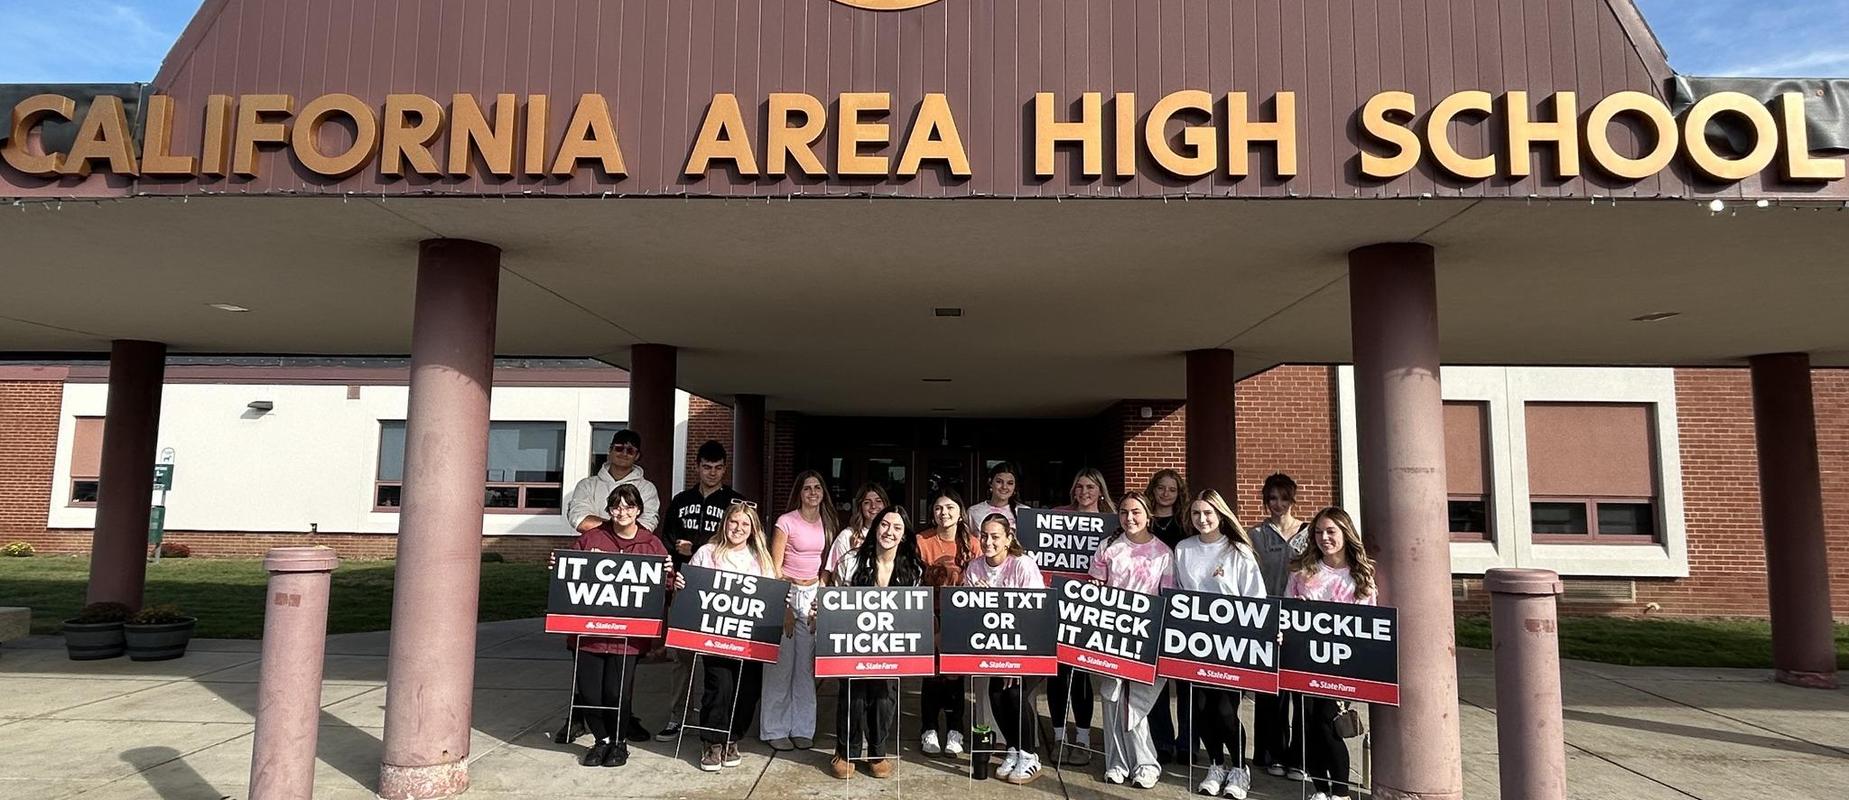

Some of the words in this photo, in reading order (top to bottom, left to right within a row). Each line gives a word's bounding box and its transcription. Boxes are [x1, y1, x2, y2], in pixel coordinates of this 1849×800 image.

[0, 93, 628, 178] CALIFORNIA
[684, 92, 972, 180] AREA
[1035, 89, 1297, 178] HIGH
[1359, 90, 1846, 182] SCHOOL
[706, 505, 724, 519] GIN
[1036, 513, 1104, 533] NEVER
[1039, 532, 1100, 551] DRIVE
[557, 557, 588, 580] IT
[595, 559, 662, 585] CAN
[1024, 550, 1095, 570] MPAIR
[567, 582, 650, 608] WAIT
[698, 590, 766, 619] YOUR
[822, 590, 898, 611] CLICK
[905, 590, 928, 610] IT
[951, 590, 999, 609] ONE
[1004, 592, 1047, 609] TXT
[1063, 579, 1150, 614] COULD
[856, 611, 895, 632] OR
[983, 612, 1015, 630] OR
[1058, 600, 1152, 639] WRECK
[1169, 593, 1271, 629] SLOW
[700, 614, 754, 639] LIFE
[1279, 608, 1392, 642] BUCKLE
[829, 632, 922, 654] TICKET
[970, 632, 1028, 651] CALL
[1057, 623, 1082, 645] IT
[1085, 630, 1143, 660] ALL!
[1164, 628, 1273, 668] DOWN
[1309, 639, 1352, 666] UP
